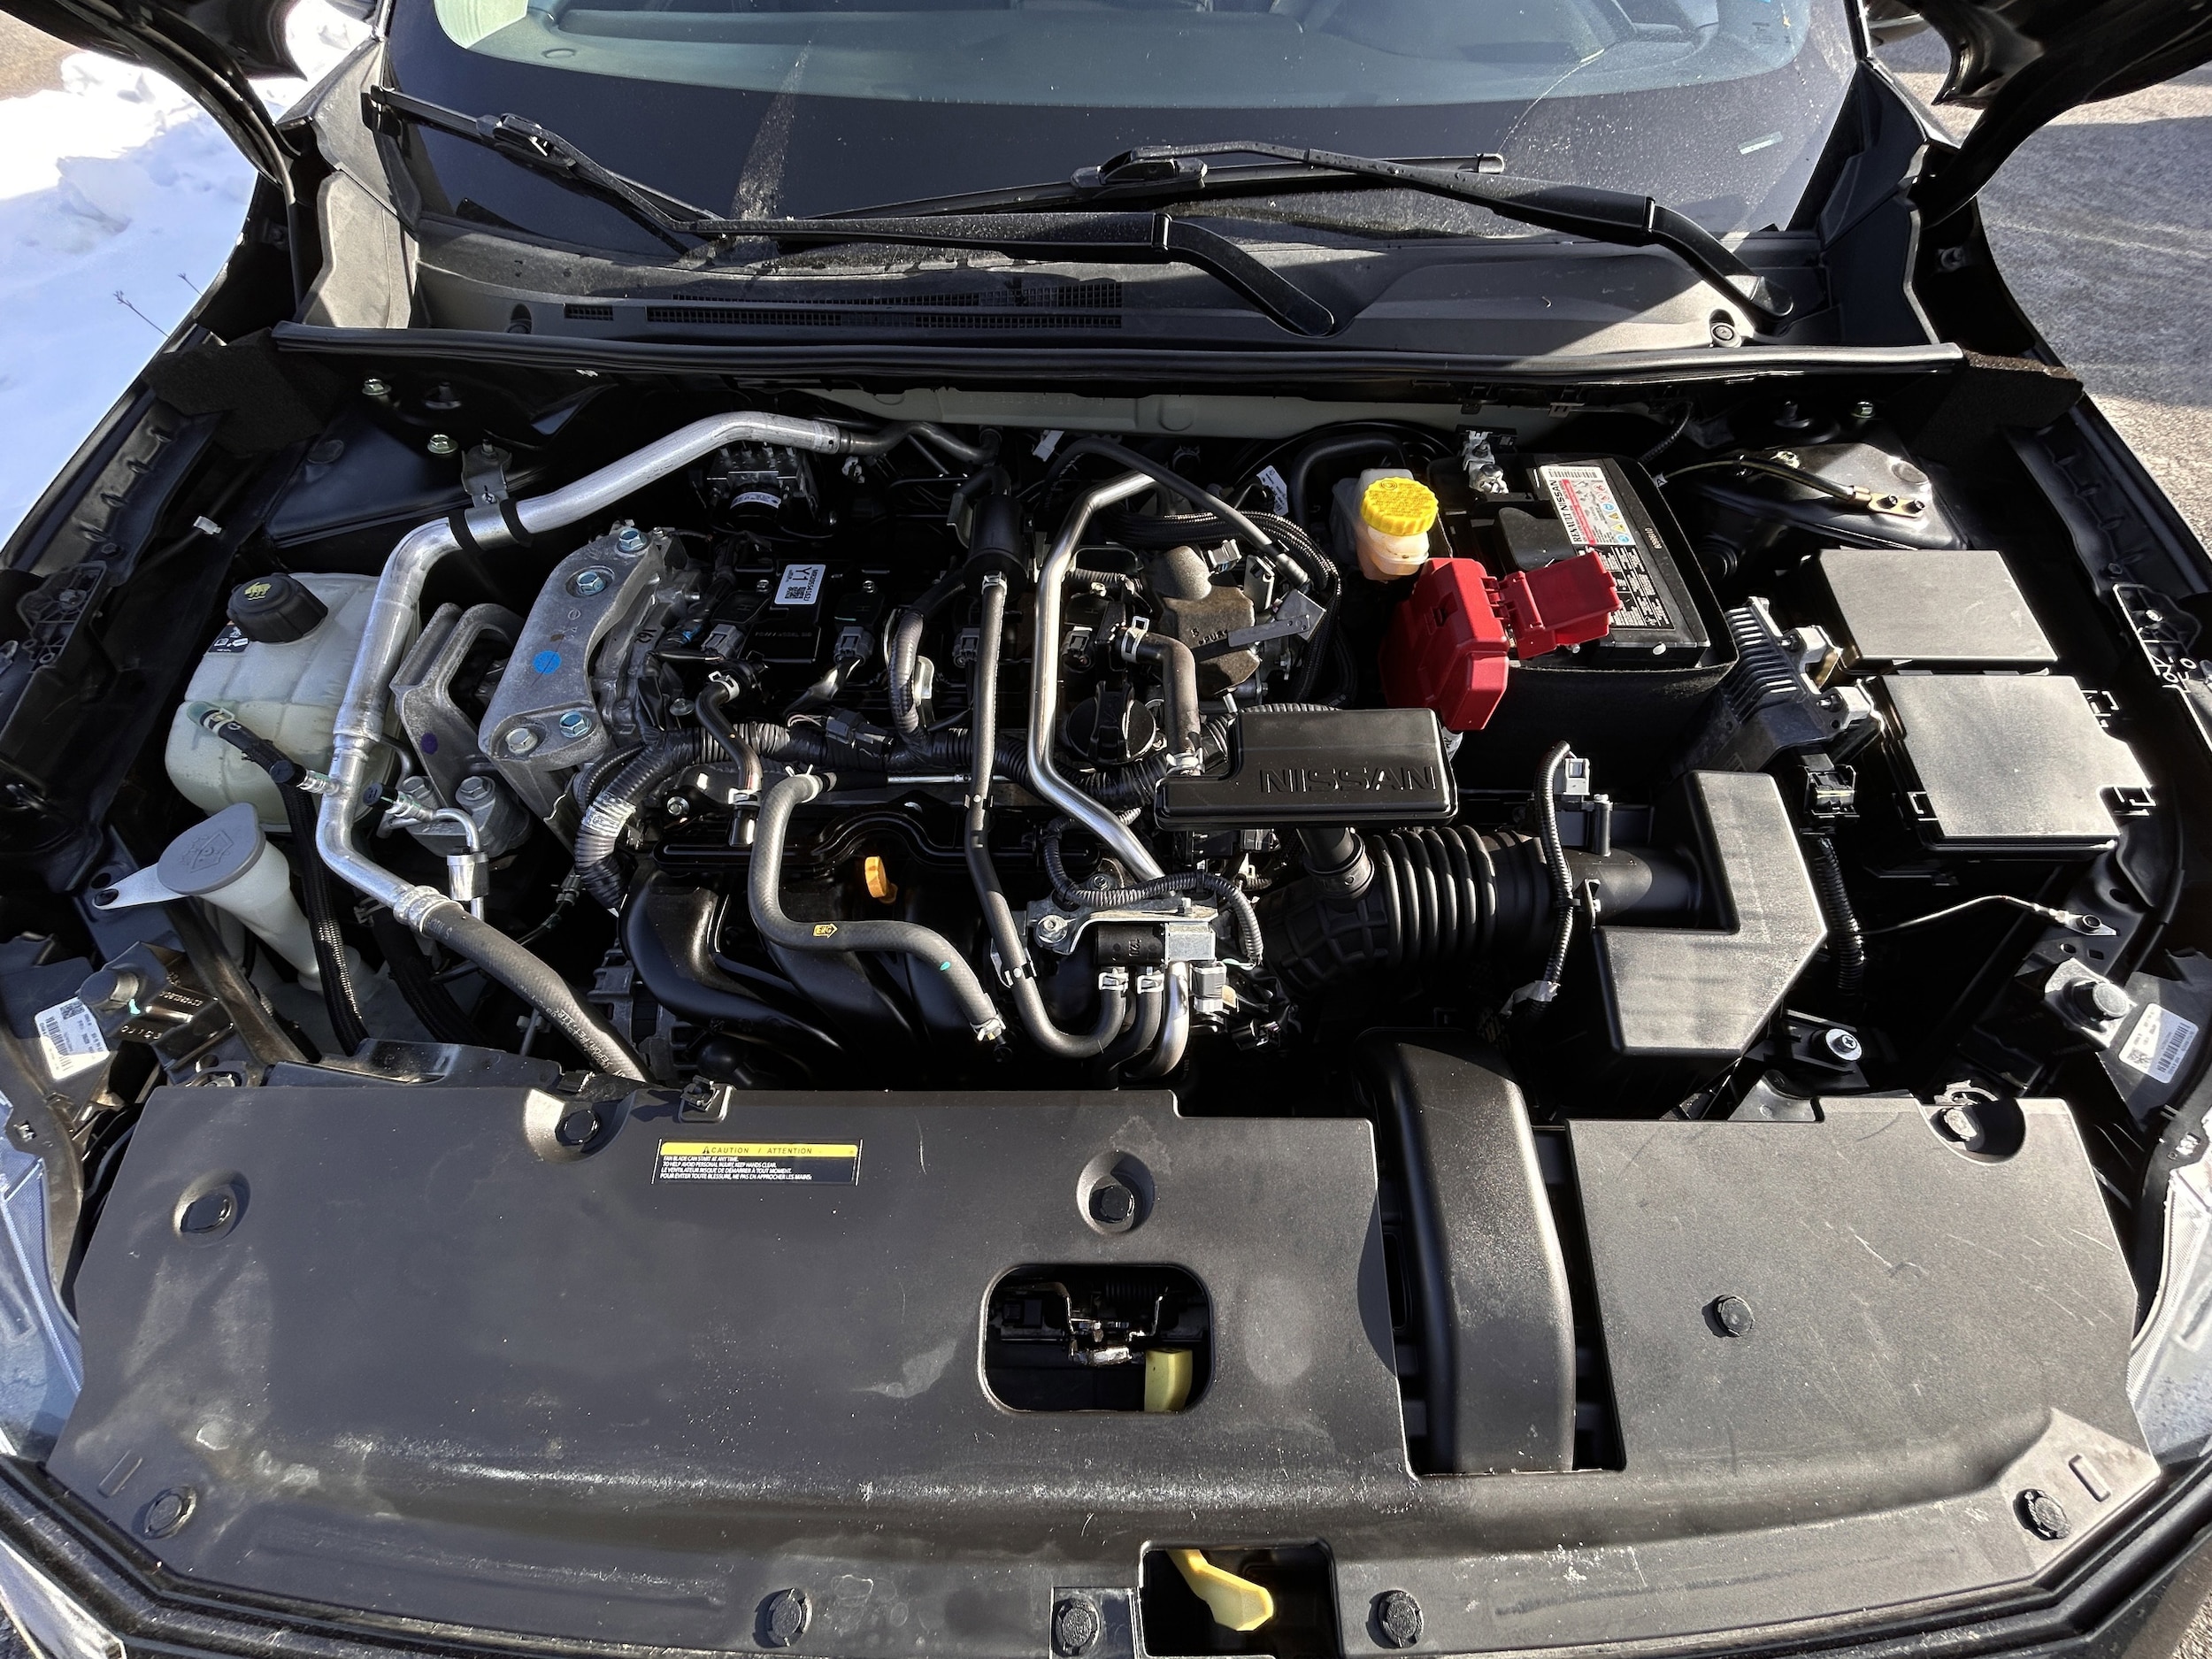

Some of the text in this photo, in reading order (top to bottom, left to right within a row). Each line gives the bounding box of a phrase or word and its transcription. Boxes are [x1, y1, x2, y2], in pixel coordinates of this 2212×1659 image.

[1548, 480, 1570, 511] NISSAN
[1563, 512, 1583, 542] RENAULT
[792, 566, 812, 580] Y1
[1259, 765, 1438, 795] NISSAN
